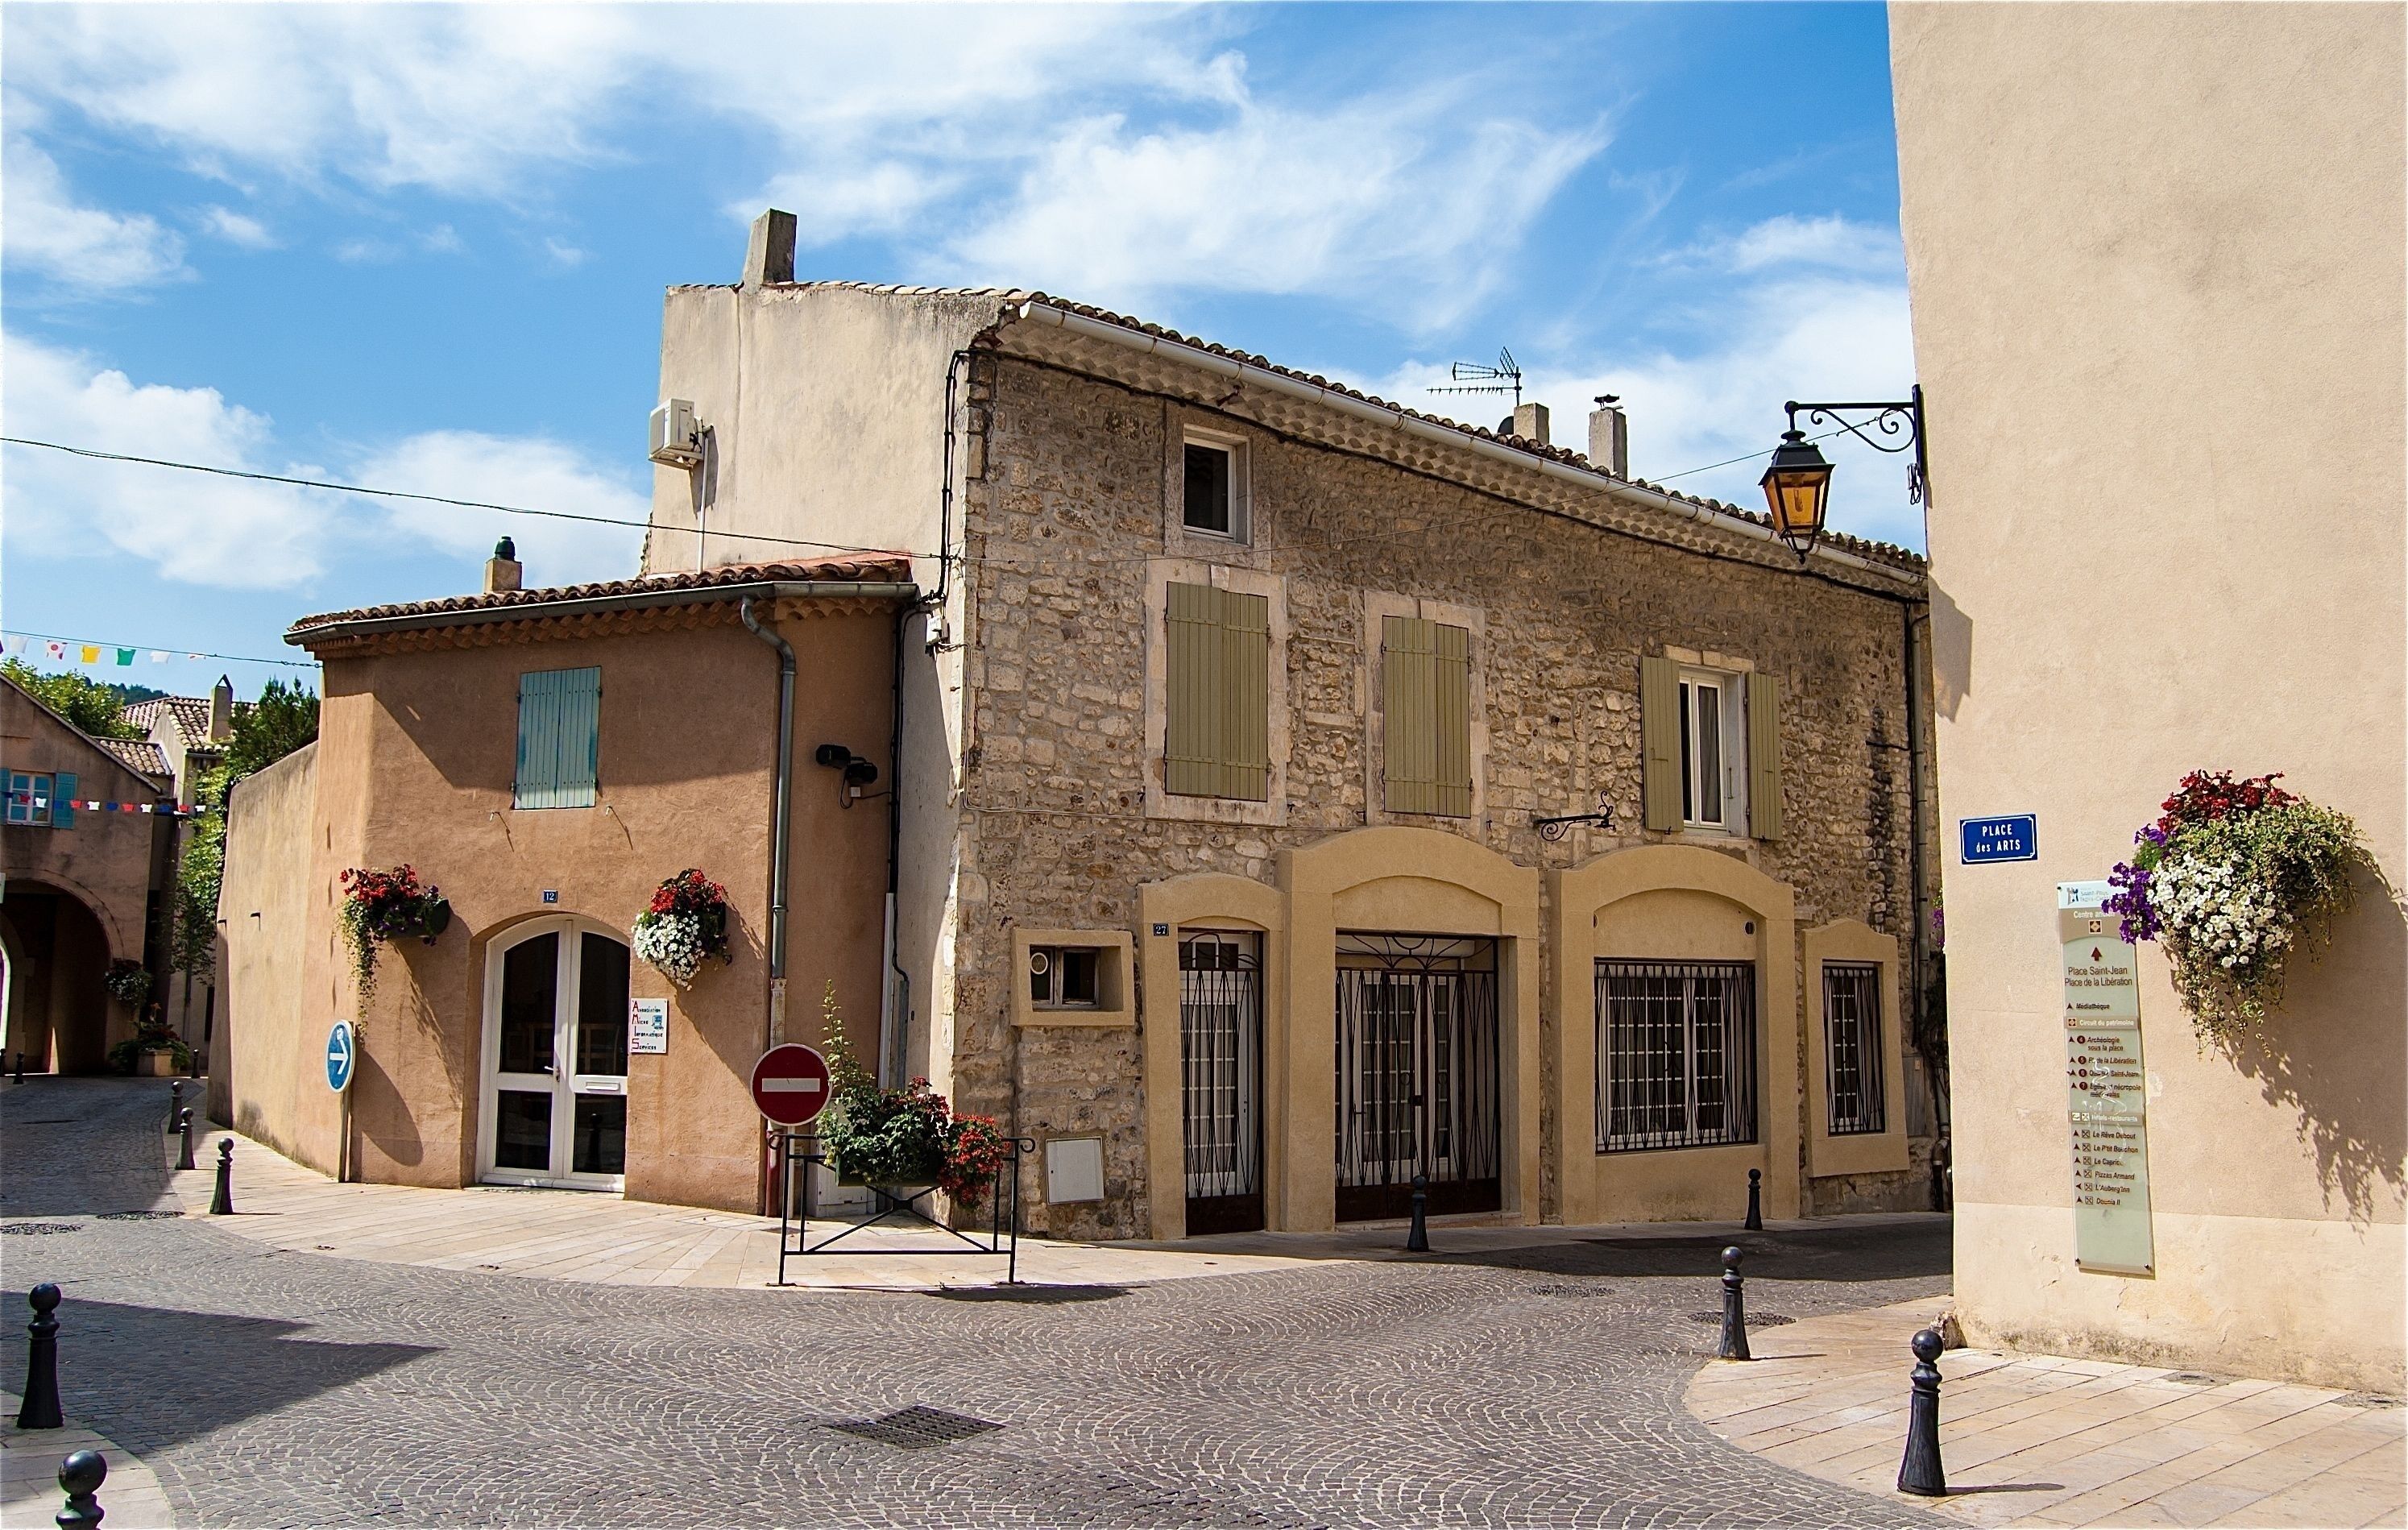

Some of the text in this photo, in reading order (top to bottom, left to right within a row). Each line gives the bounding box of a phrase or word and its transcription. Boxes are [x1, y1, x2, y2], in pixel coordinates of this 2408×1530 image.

[1982, 823, 2012, 837] PLACE
[1975, 839, 2020, 853] des ARTS
[546, 892, 554, 901] 12
[2073, 910, 2093, 918] Centre
[1155, 925, 1167, 935] 27
[2068, 966, 2128, 976] Place Saint-Jean
[2064, 976, 2132, 986] Place de la Libération
[2075, 1002, 2110, 1010] Médiathèque
[2106, 1019, 2134, 1027] patrimoine
[2087, 1036, 2120, 1045] Archéologie
[2108, 1044, 2124, 1053] place
[2100, 1130, 2115, 1138] Rêve
[2116, 1132, 2136, 1140] Debout
[2113, 1145, 2138, 1153] Bouchon
[2095, 1171, 2135, 1180] Pizzas Armand
